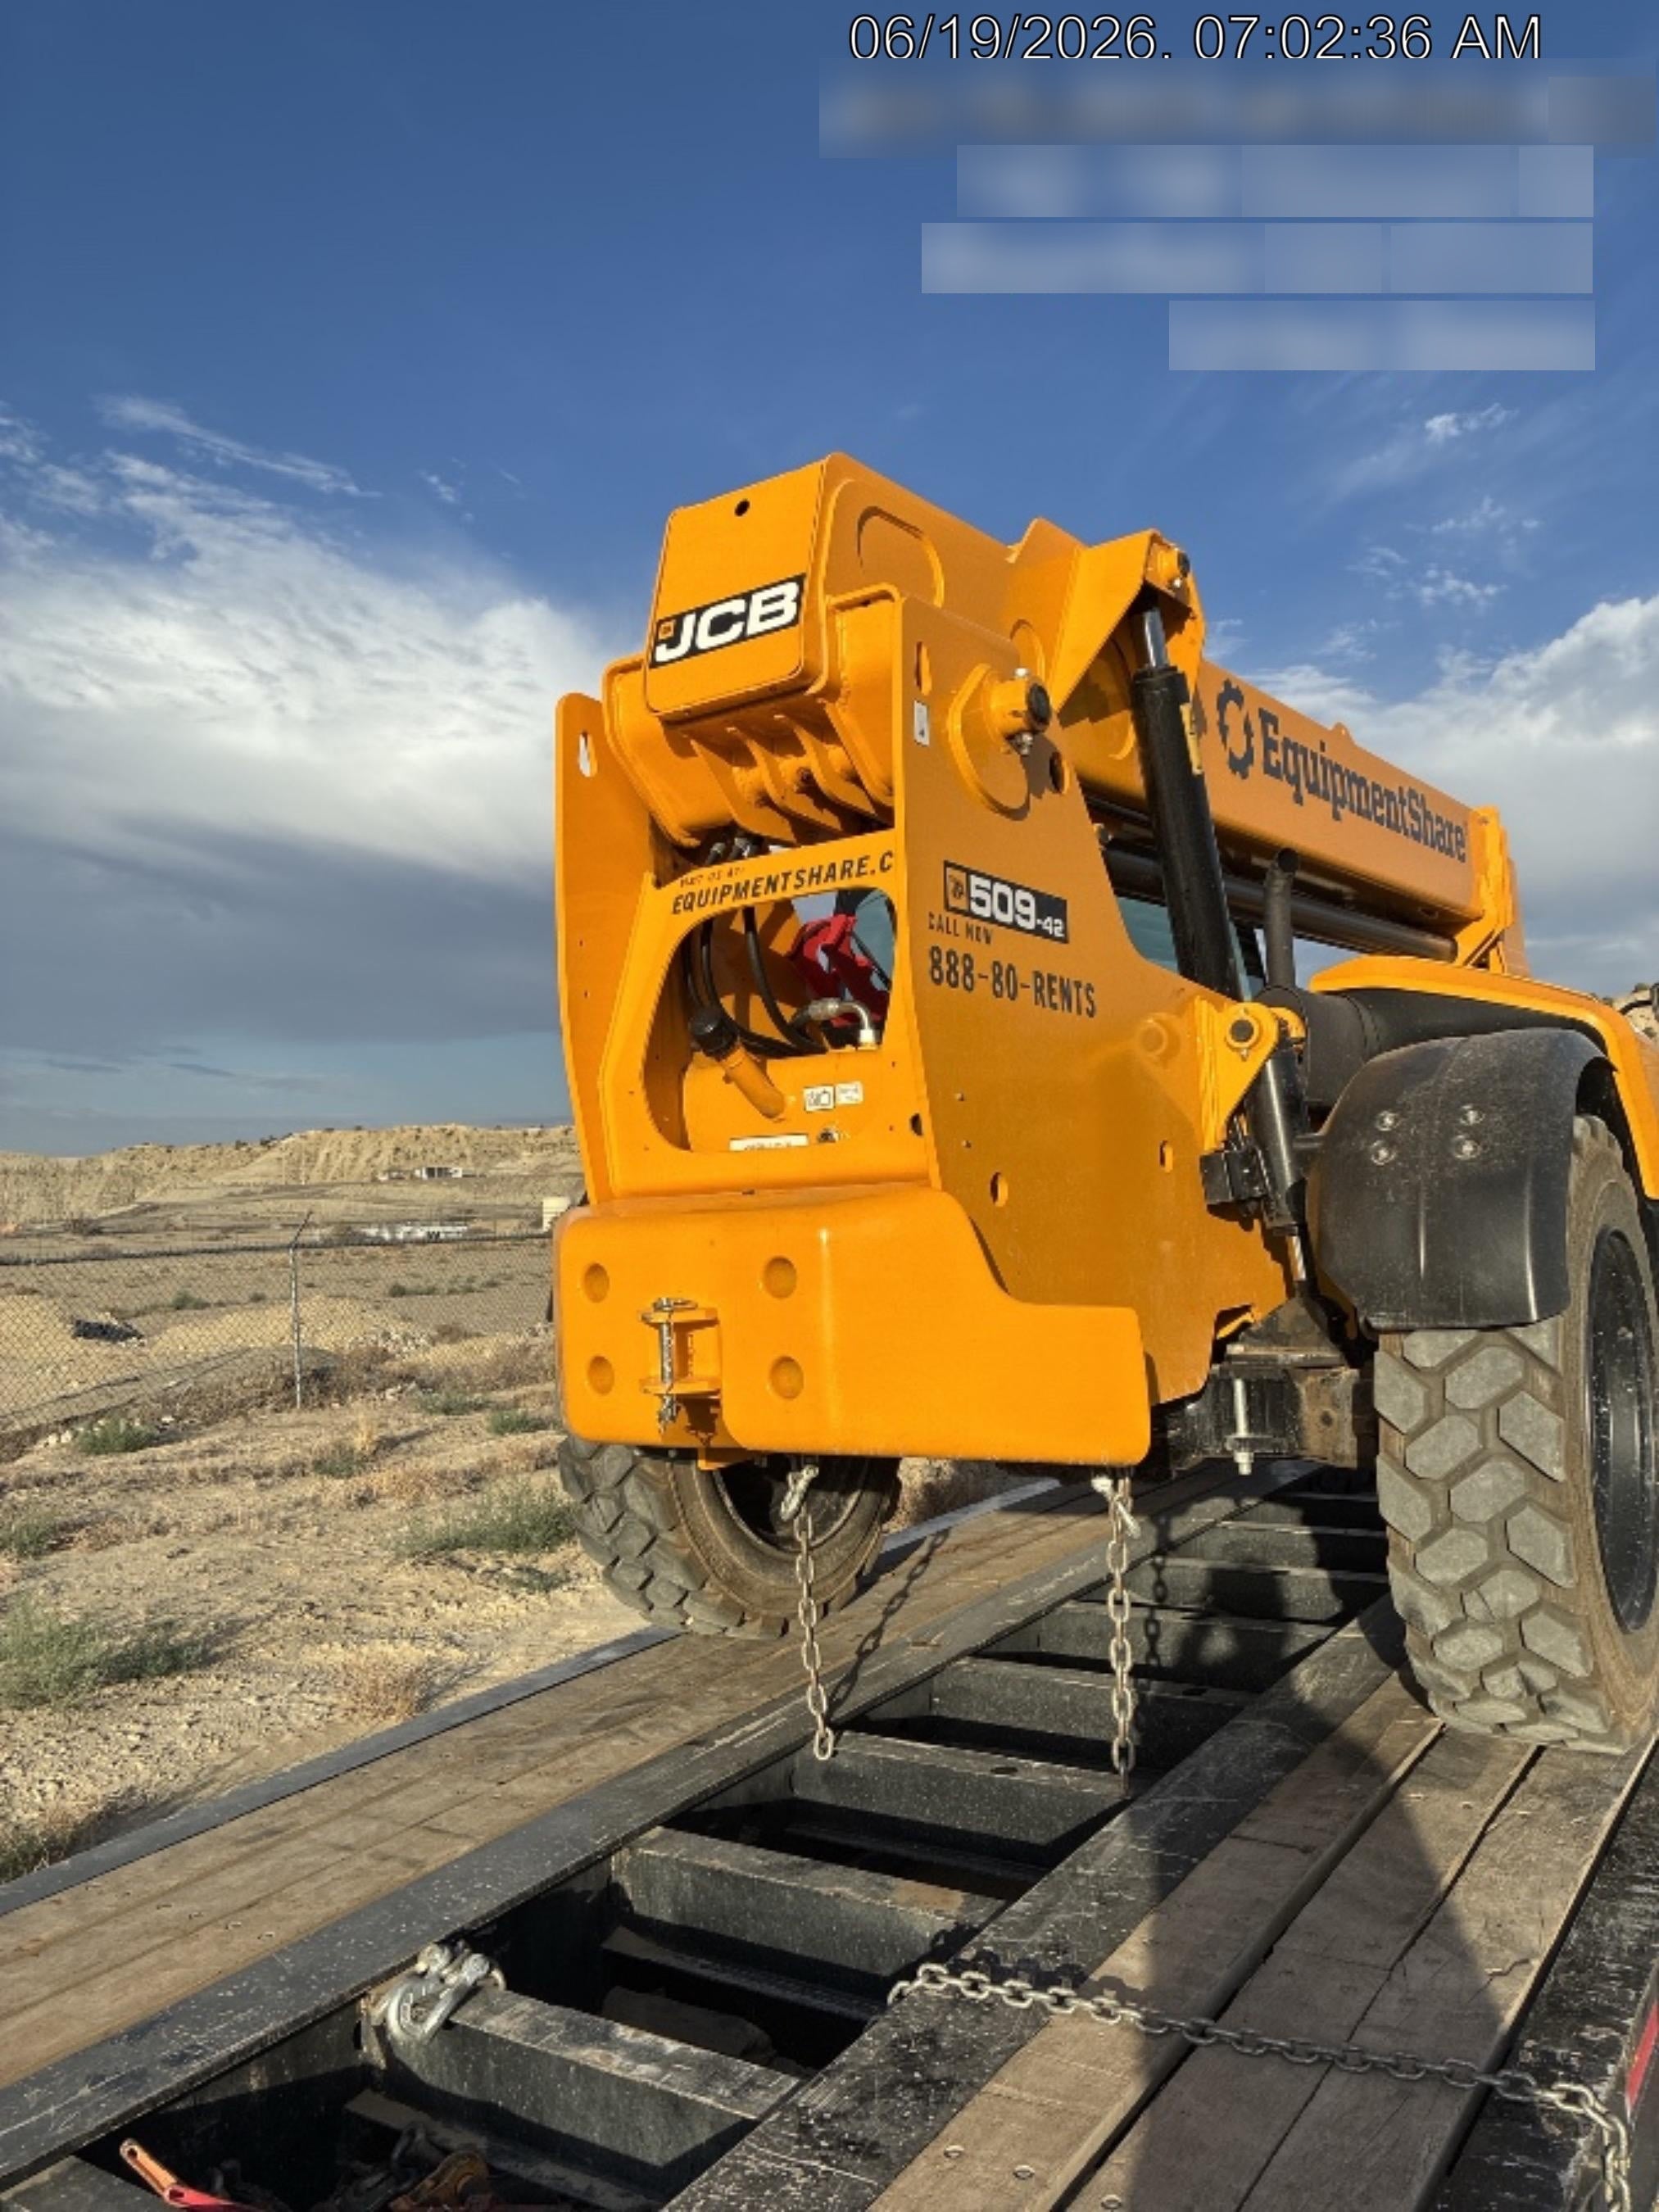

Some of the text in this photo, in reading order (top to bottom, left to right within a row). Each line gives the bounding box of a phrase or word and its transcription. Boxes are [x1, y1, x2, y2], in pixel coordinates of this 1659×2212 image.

[655, 581, 800, 663] JCB
[1258, 707, 1466, 863] EquipmentShare
[672, 850, 894, 915] EQUIPMENTSHARE.C
[969, 873, 1065, 938] 509-42
[928, 911, 960, 937] CALL
[929, 945, 1097, 1018] 888-80-RENTS
